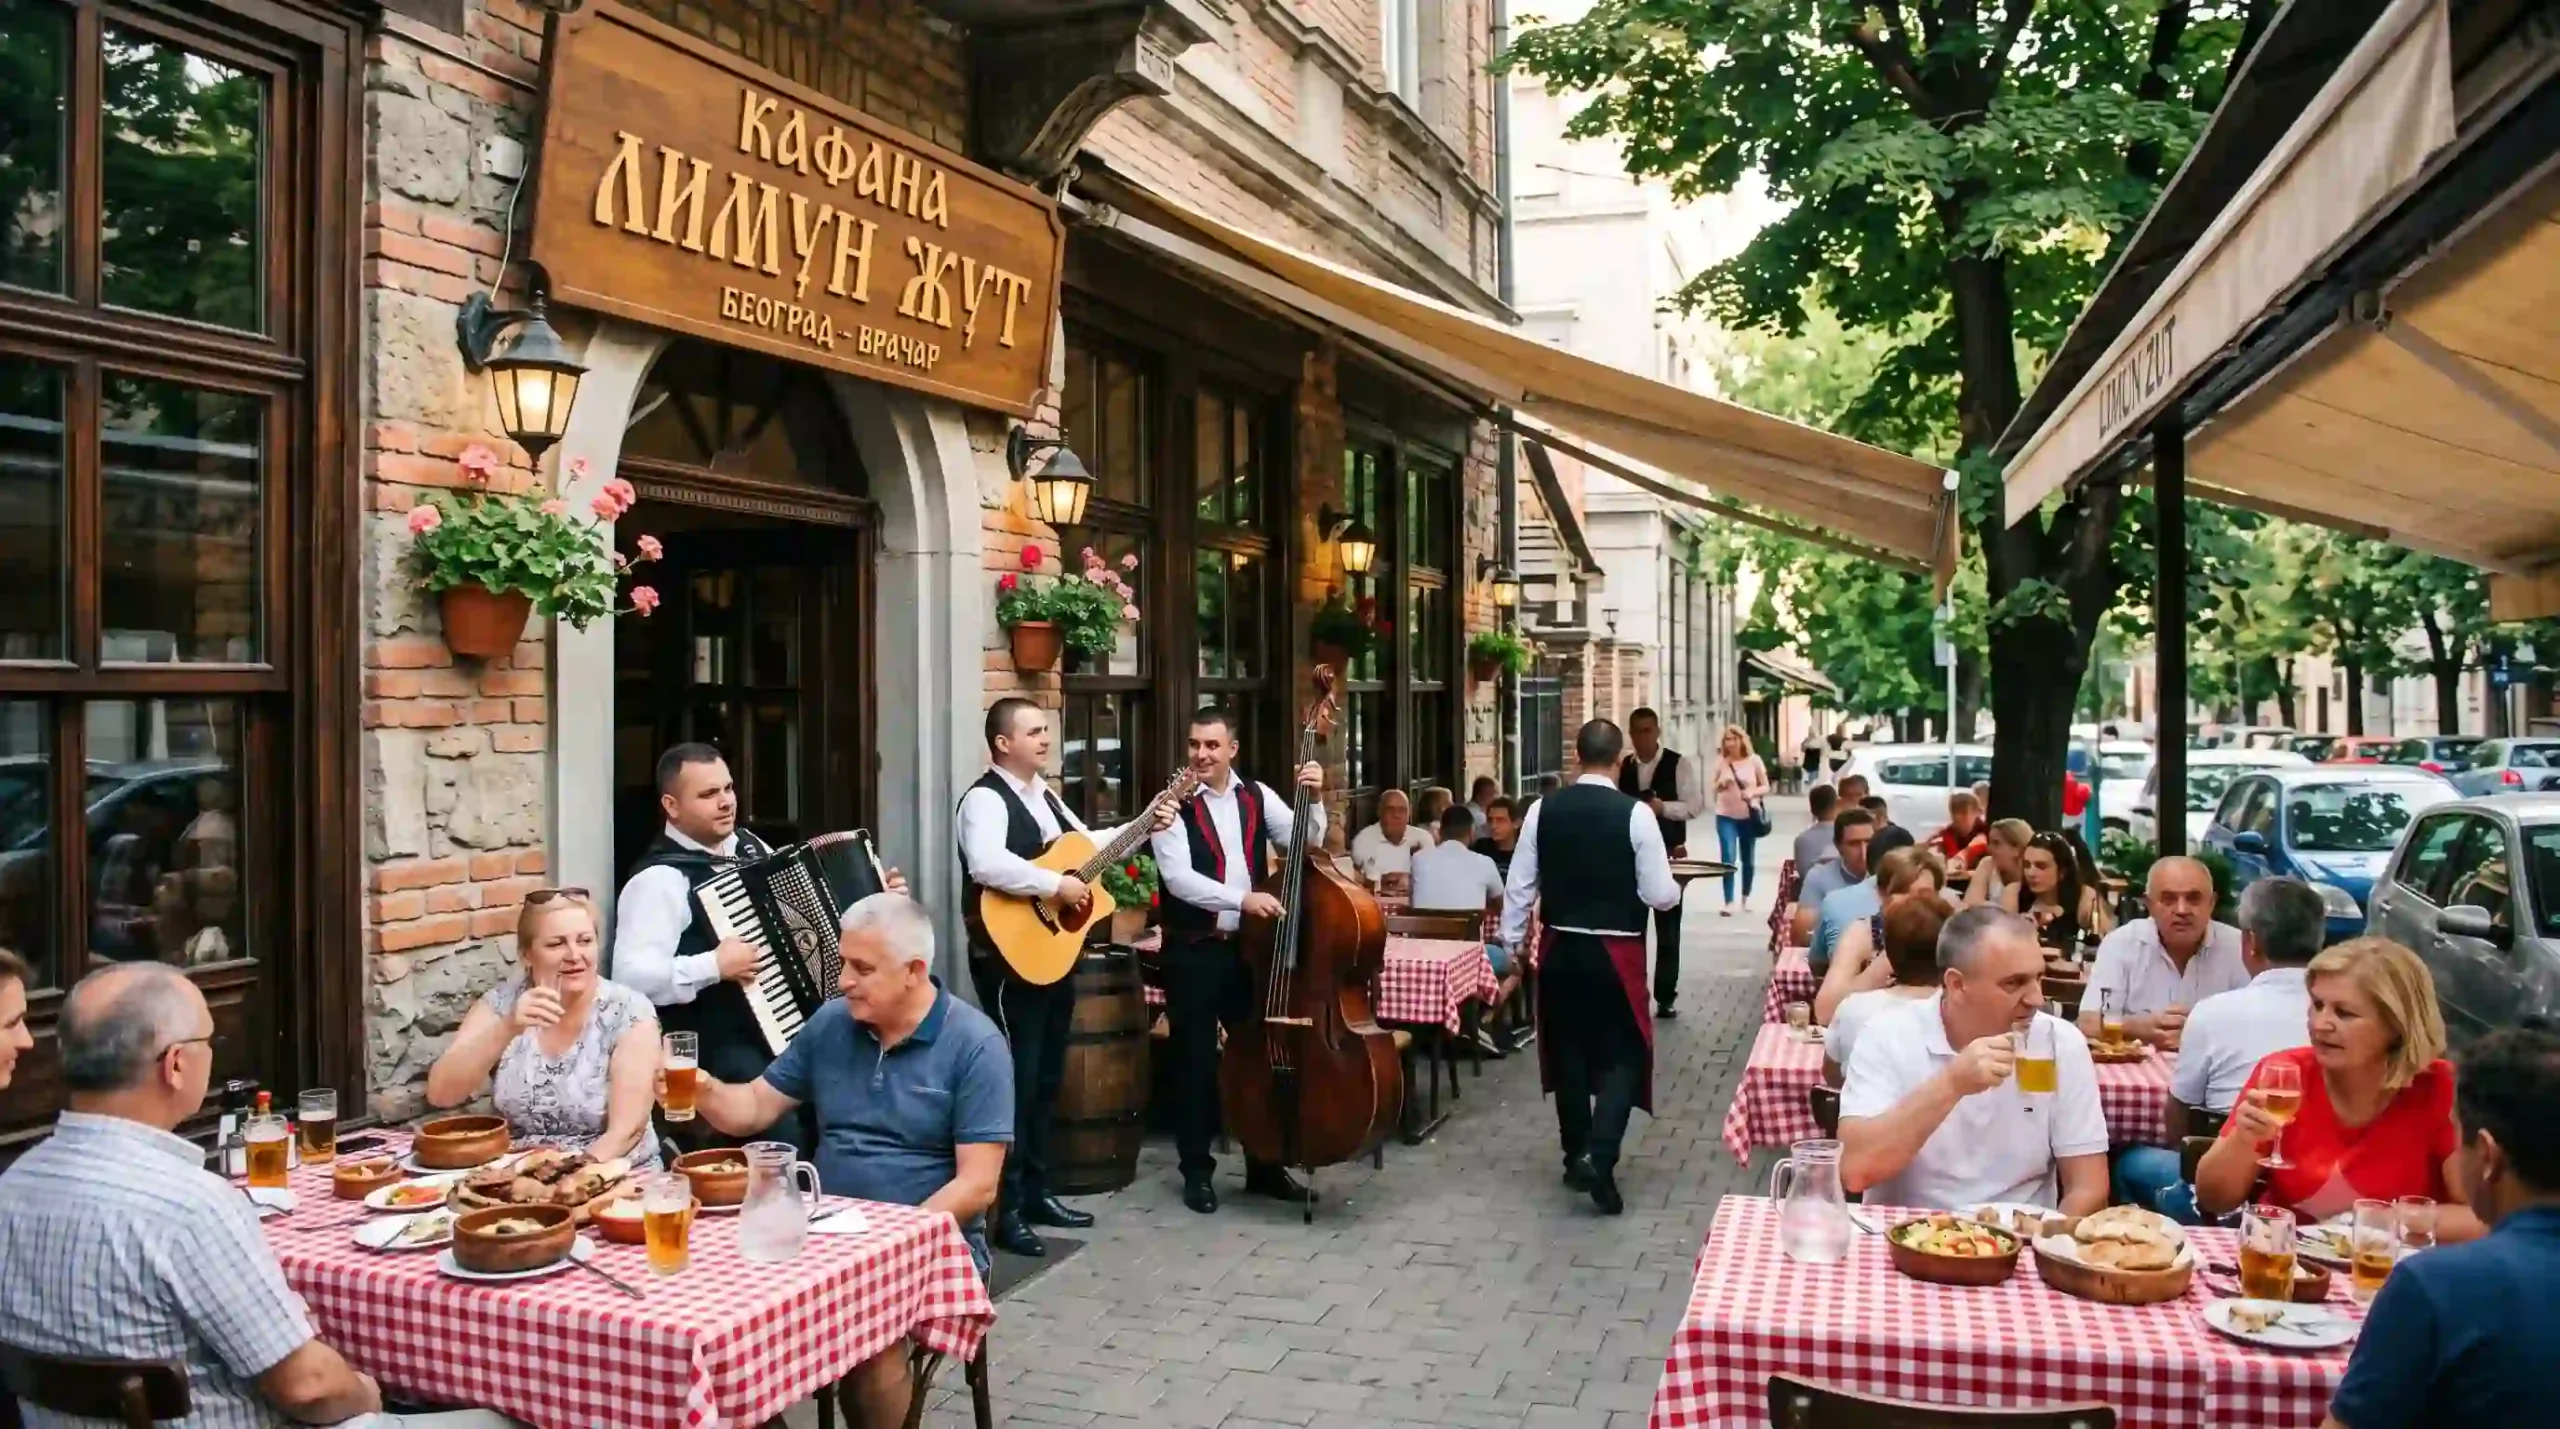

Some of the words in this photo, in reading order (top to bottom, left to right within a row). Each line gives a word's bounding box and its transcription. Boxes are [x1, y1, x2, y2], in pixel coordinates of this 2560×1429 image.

[739, 89, 948, 228] КАФАНА
[595, 131, 878, 299] ЛИМУН
[897, 236, 1032, 347] ЖУТ
[721, 286, 834, 350] БЕОГРАД
[857, 324, 941, 371] ВРАЧАР
